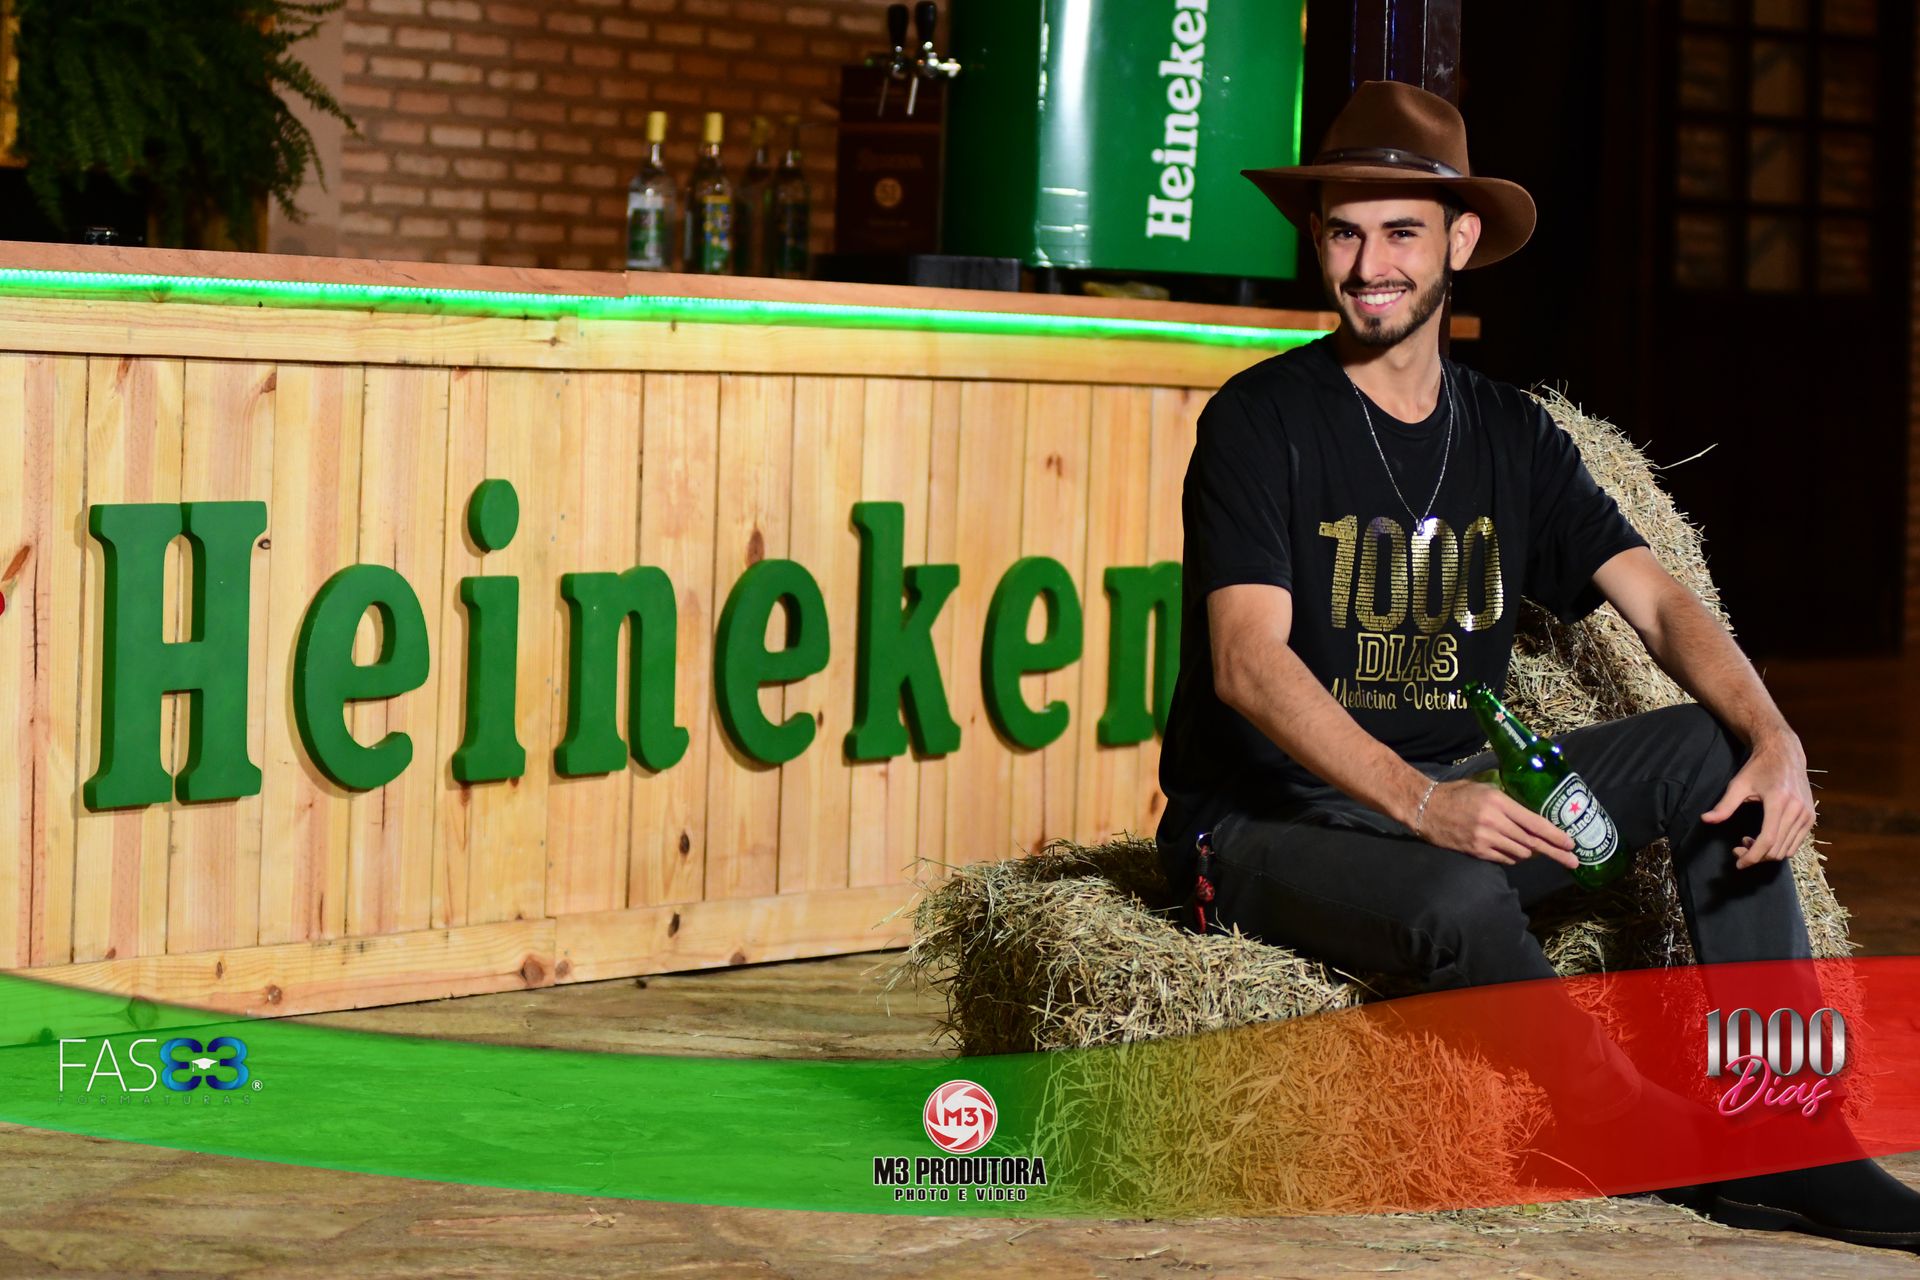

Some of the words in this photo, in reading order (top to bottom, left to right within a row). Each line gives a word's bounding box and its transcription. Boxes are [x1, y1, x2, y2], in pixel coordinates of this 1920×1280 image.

[1319, 514, 1504, 632] 1000
[83, 478, 1183, 813] Heineken
[1355, 632, 1459, 682] DIAS
[1565, 796, 1599, 837] eineke
